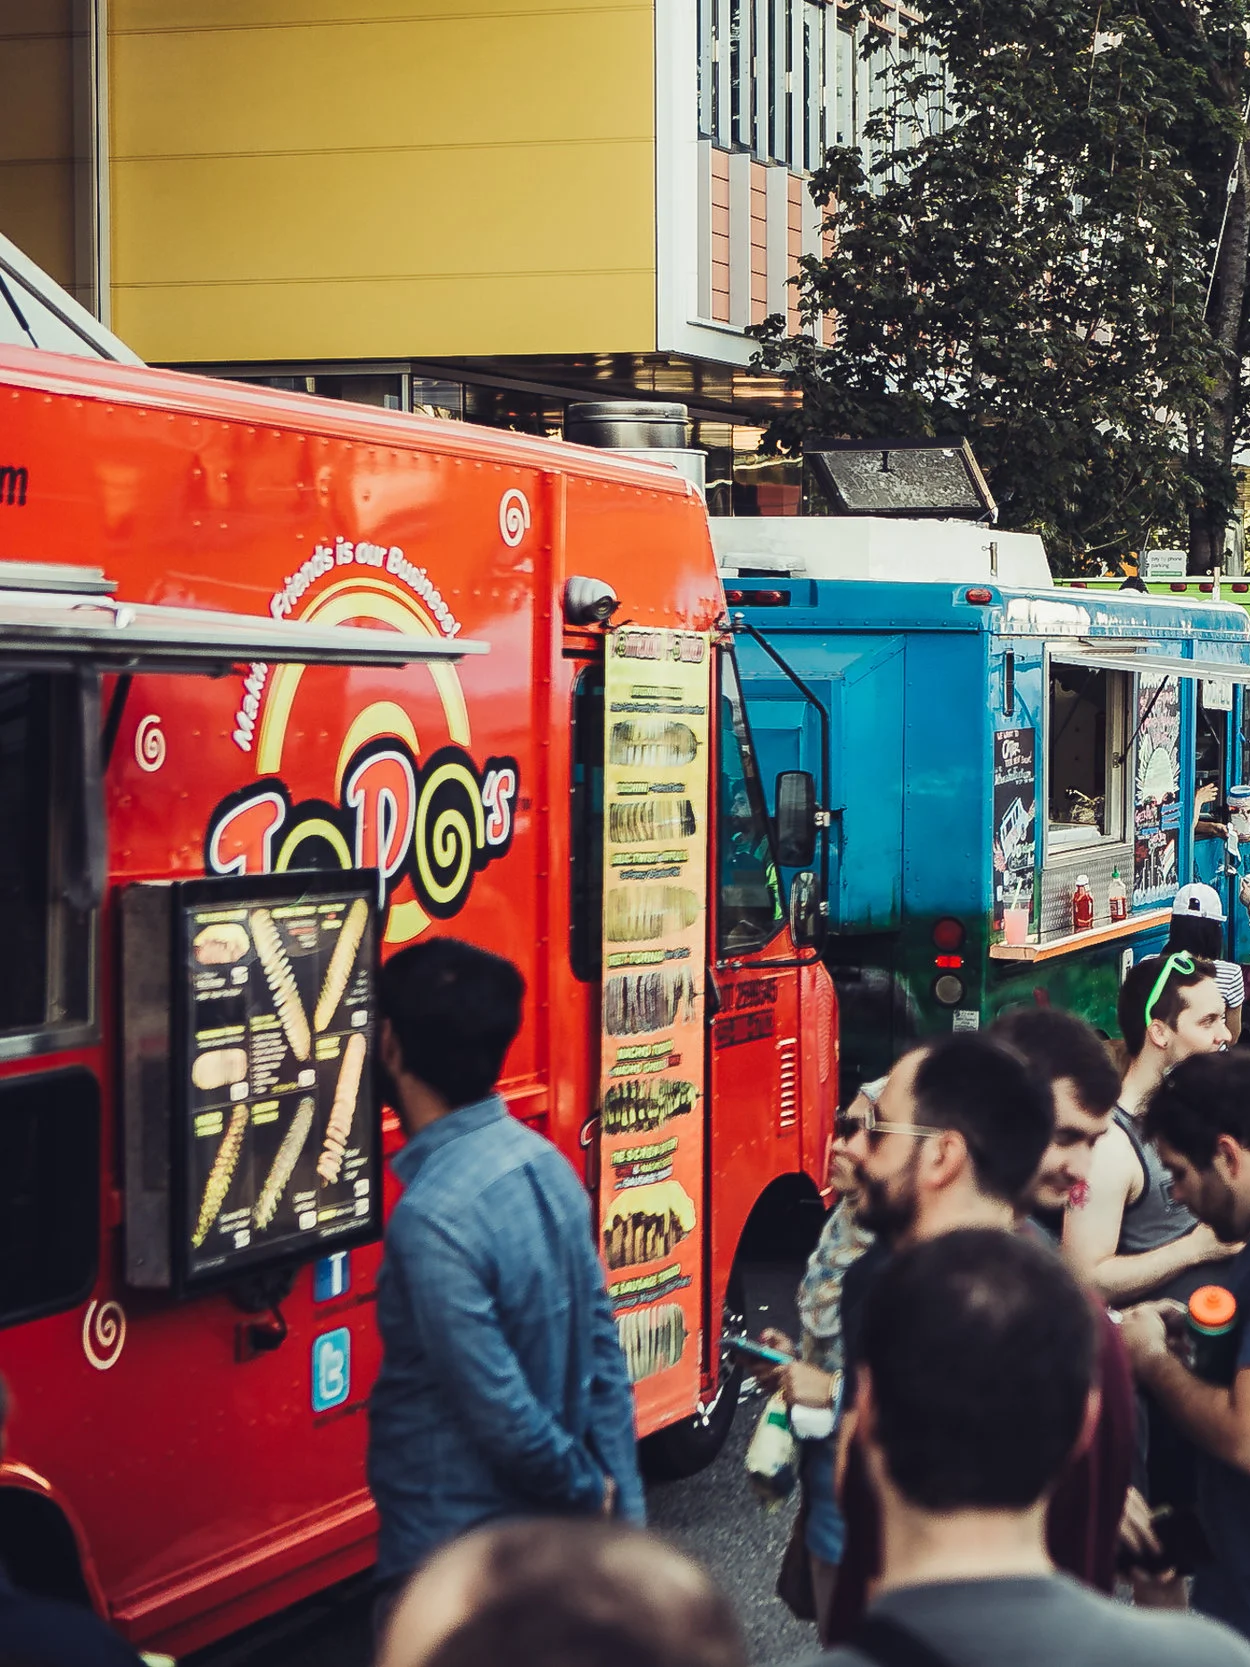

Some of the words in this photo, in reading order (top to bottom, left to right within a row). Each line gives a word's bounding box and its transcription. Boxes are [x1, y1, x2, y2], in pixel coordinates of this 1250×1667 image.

[270, 544, 334, 620] Friends
[336, 535, 354, 566] is
[354, 541, 388, 567] our
[386, 546, 461, 639] Business!
